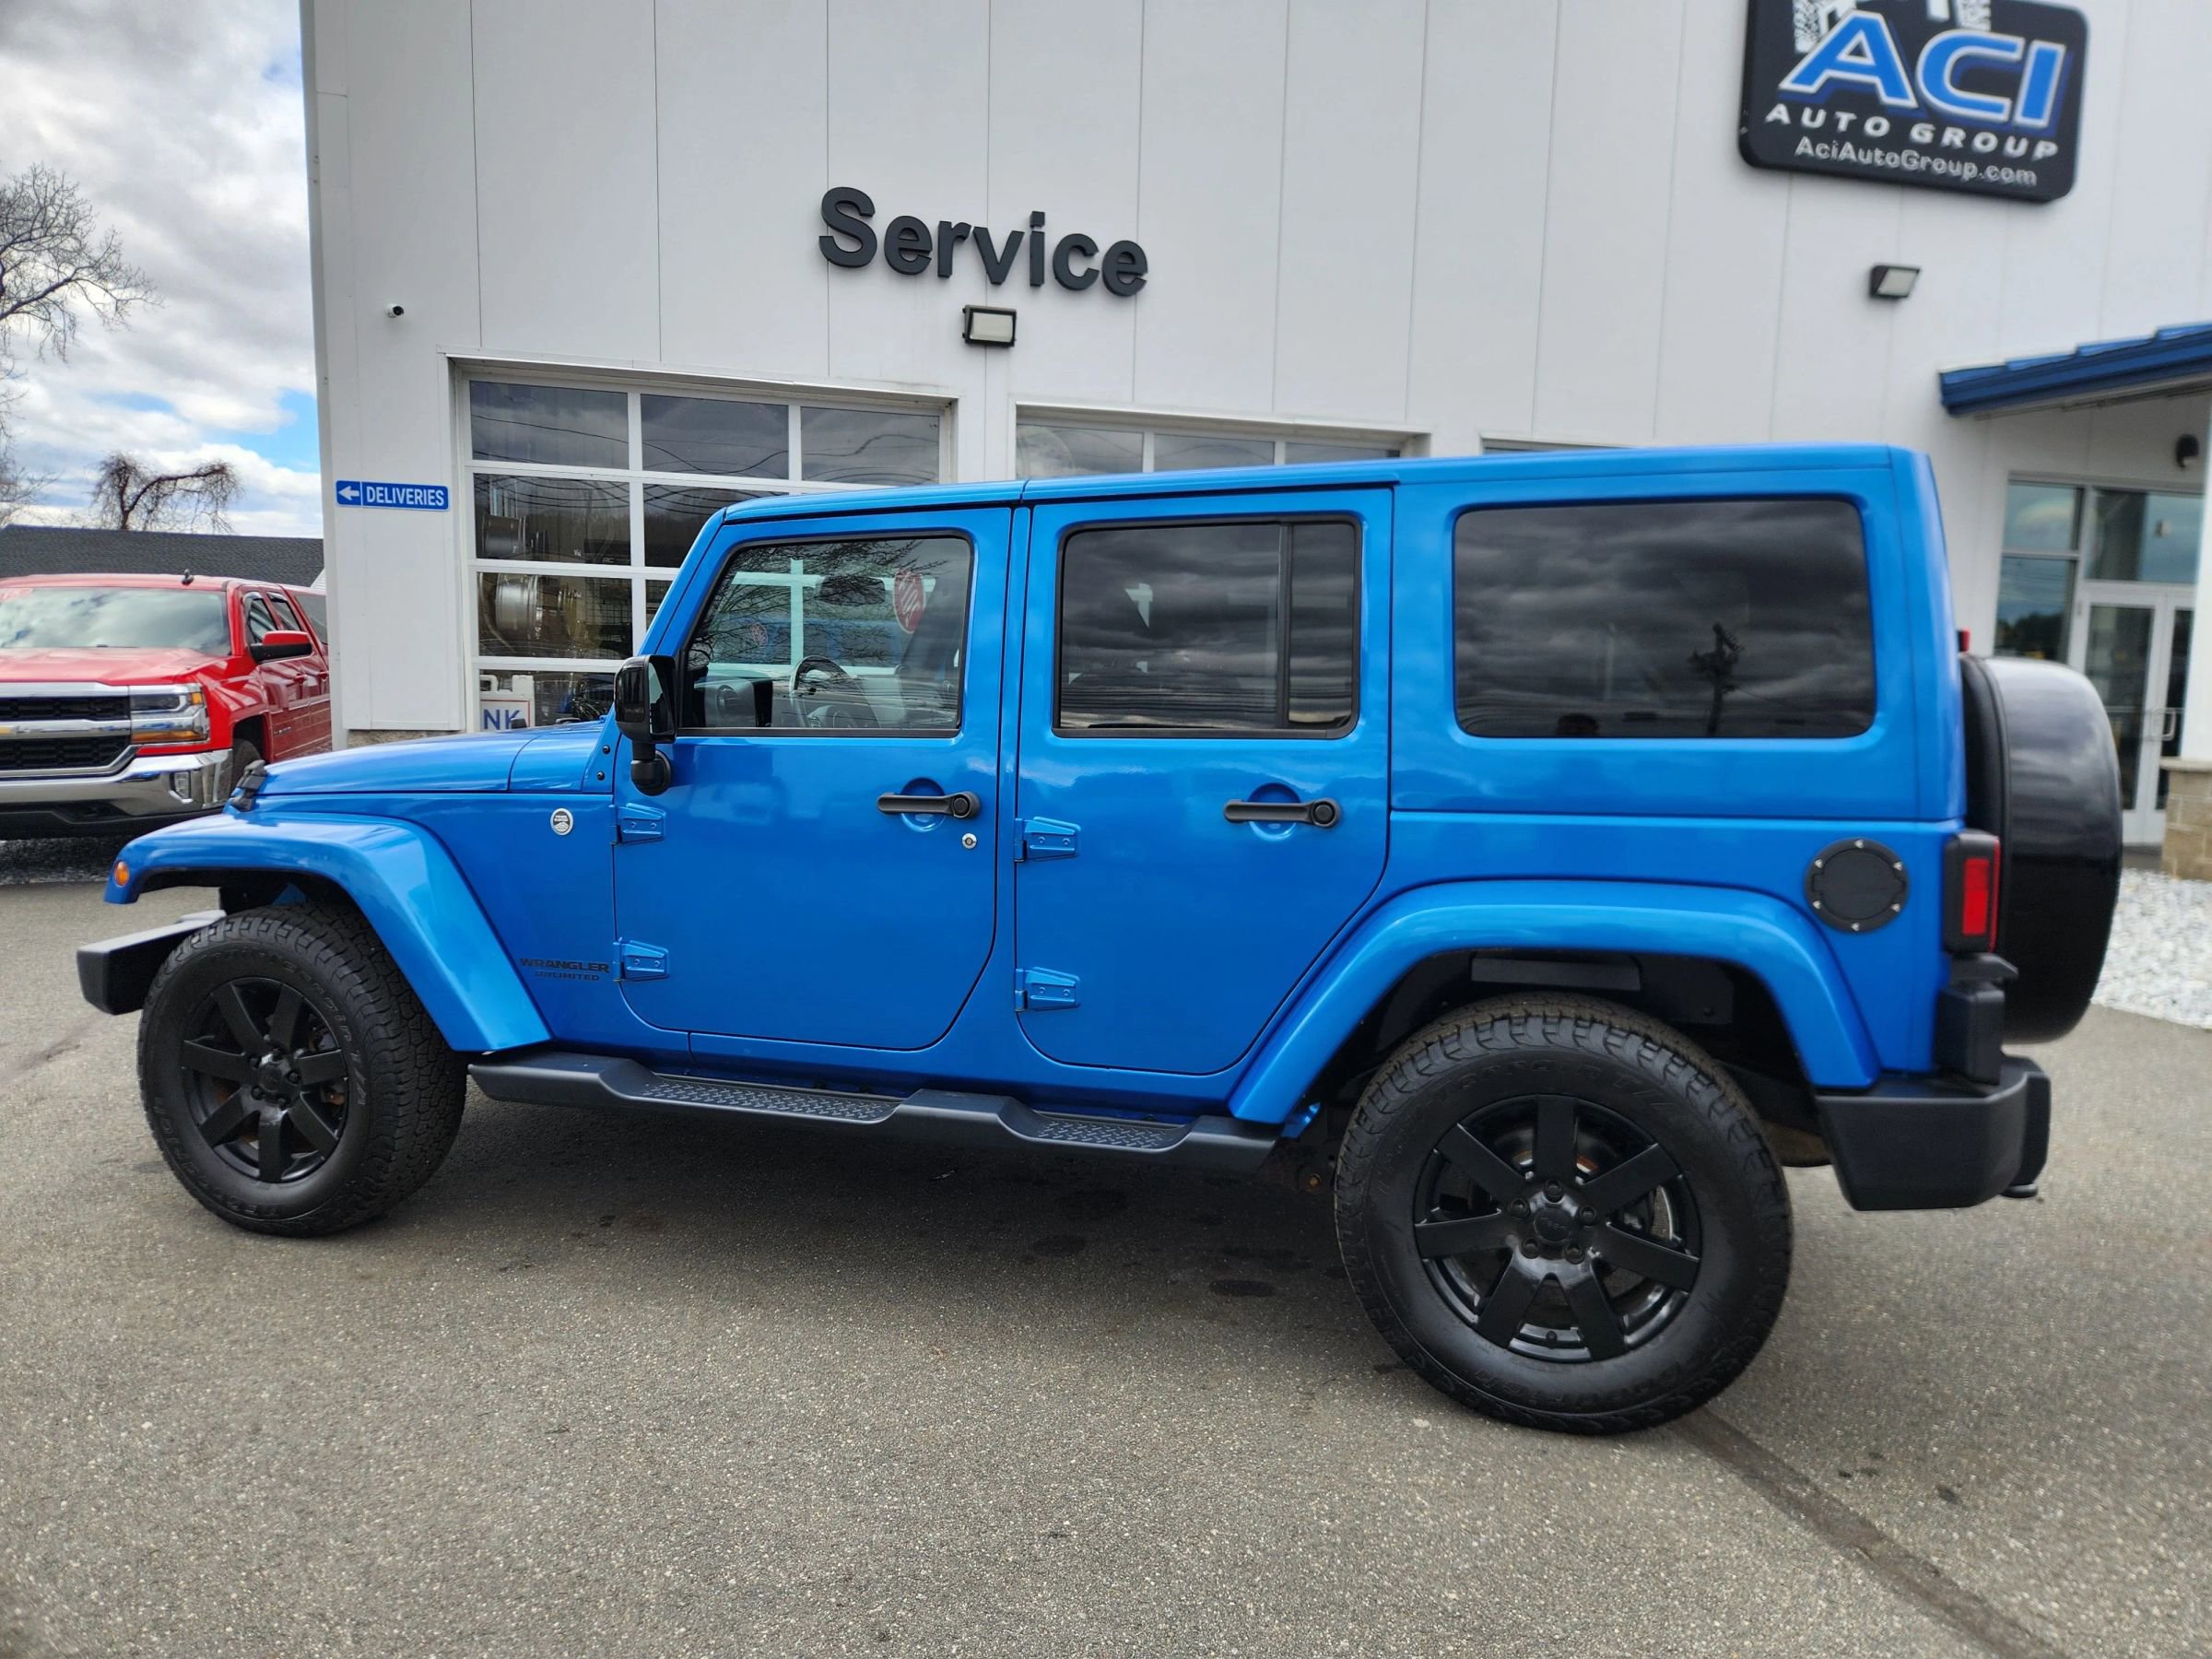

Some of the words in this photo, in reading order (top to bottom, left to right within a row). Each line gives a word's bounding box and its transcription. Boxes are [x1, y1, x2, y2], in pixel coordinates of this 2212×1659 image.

[1778, 9, 2066, 129] ACI
[1764, 102, 1891, 138] AUTO
[1909, 121, 2059, 161] GROUP
[1794, 136, 2038, 185] AciAutoGroup.com
[818, 186, 1148, 297] Service
[366, 486, 444, 506] DELIVERIES
[519, 959, 610, 973] WRANGLER
